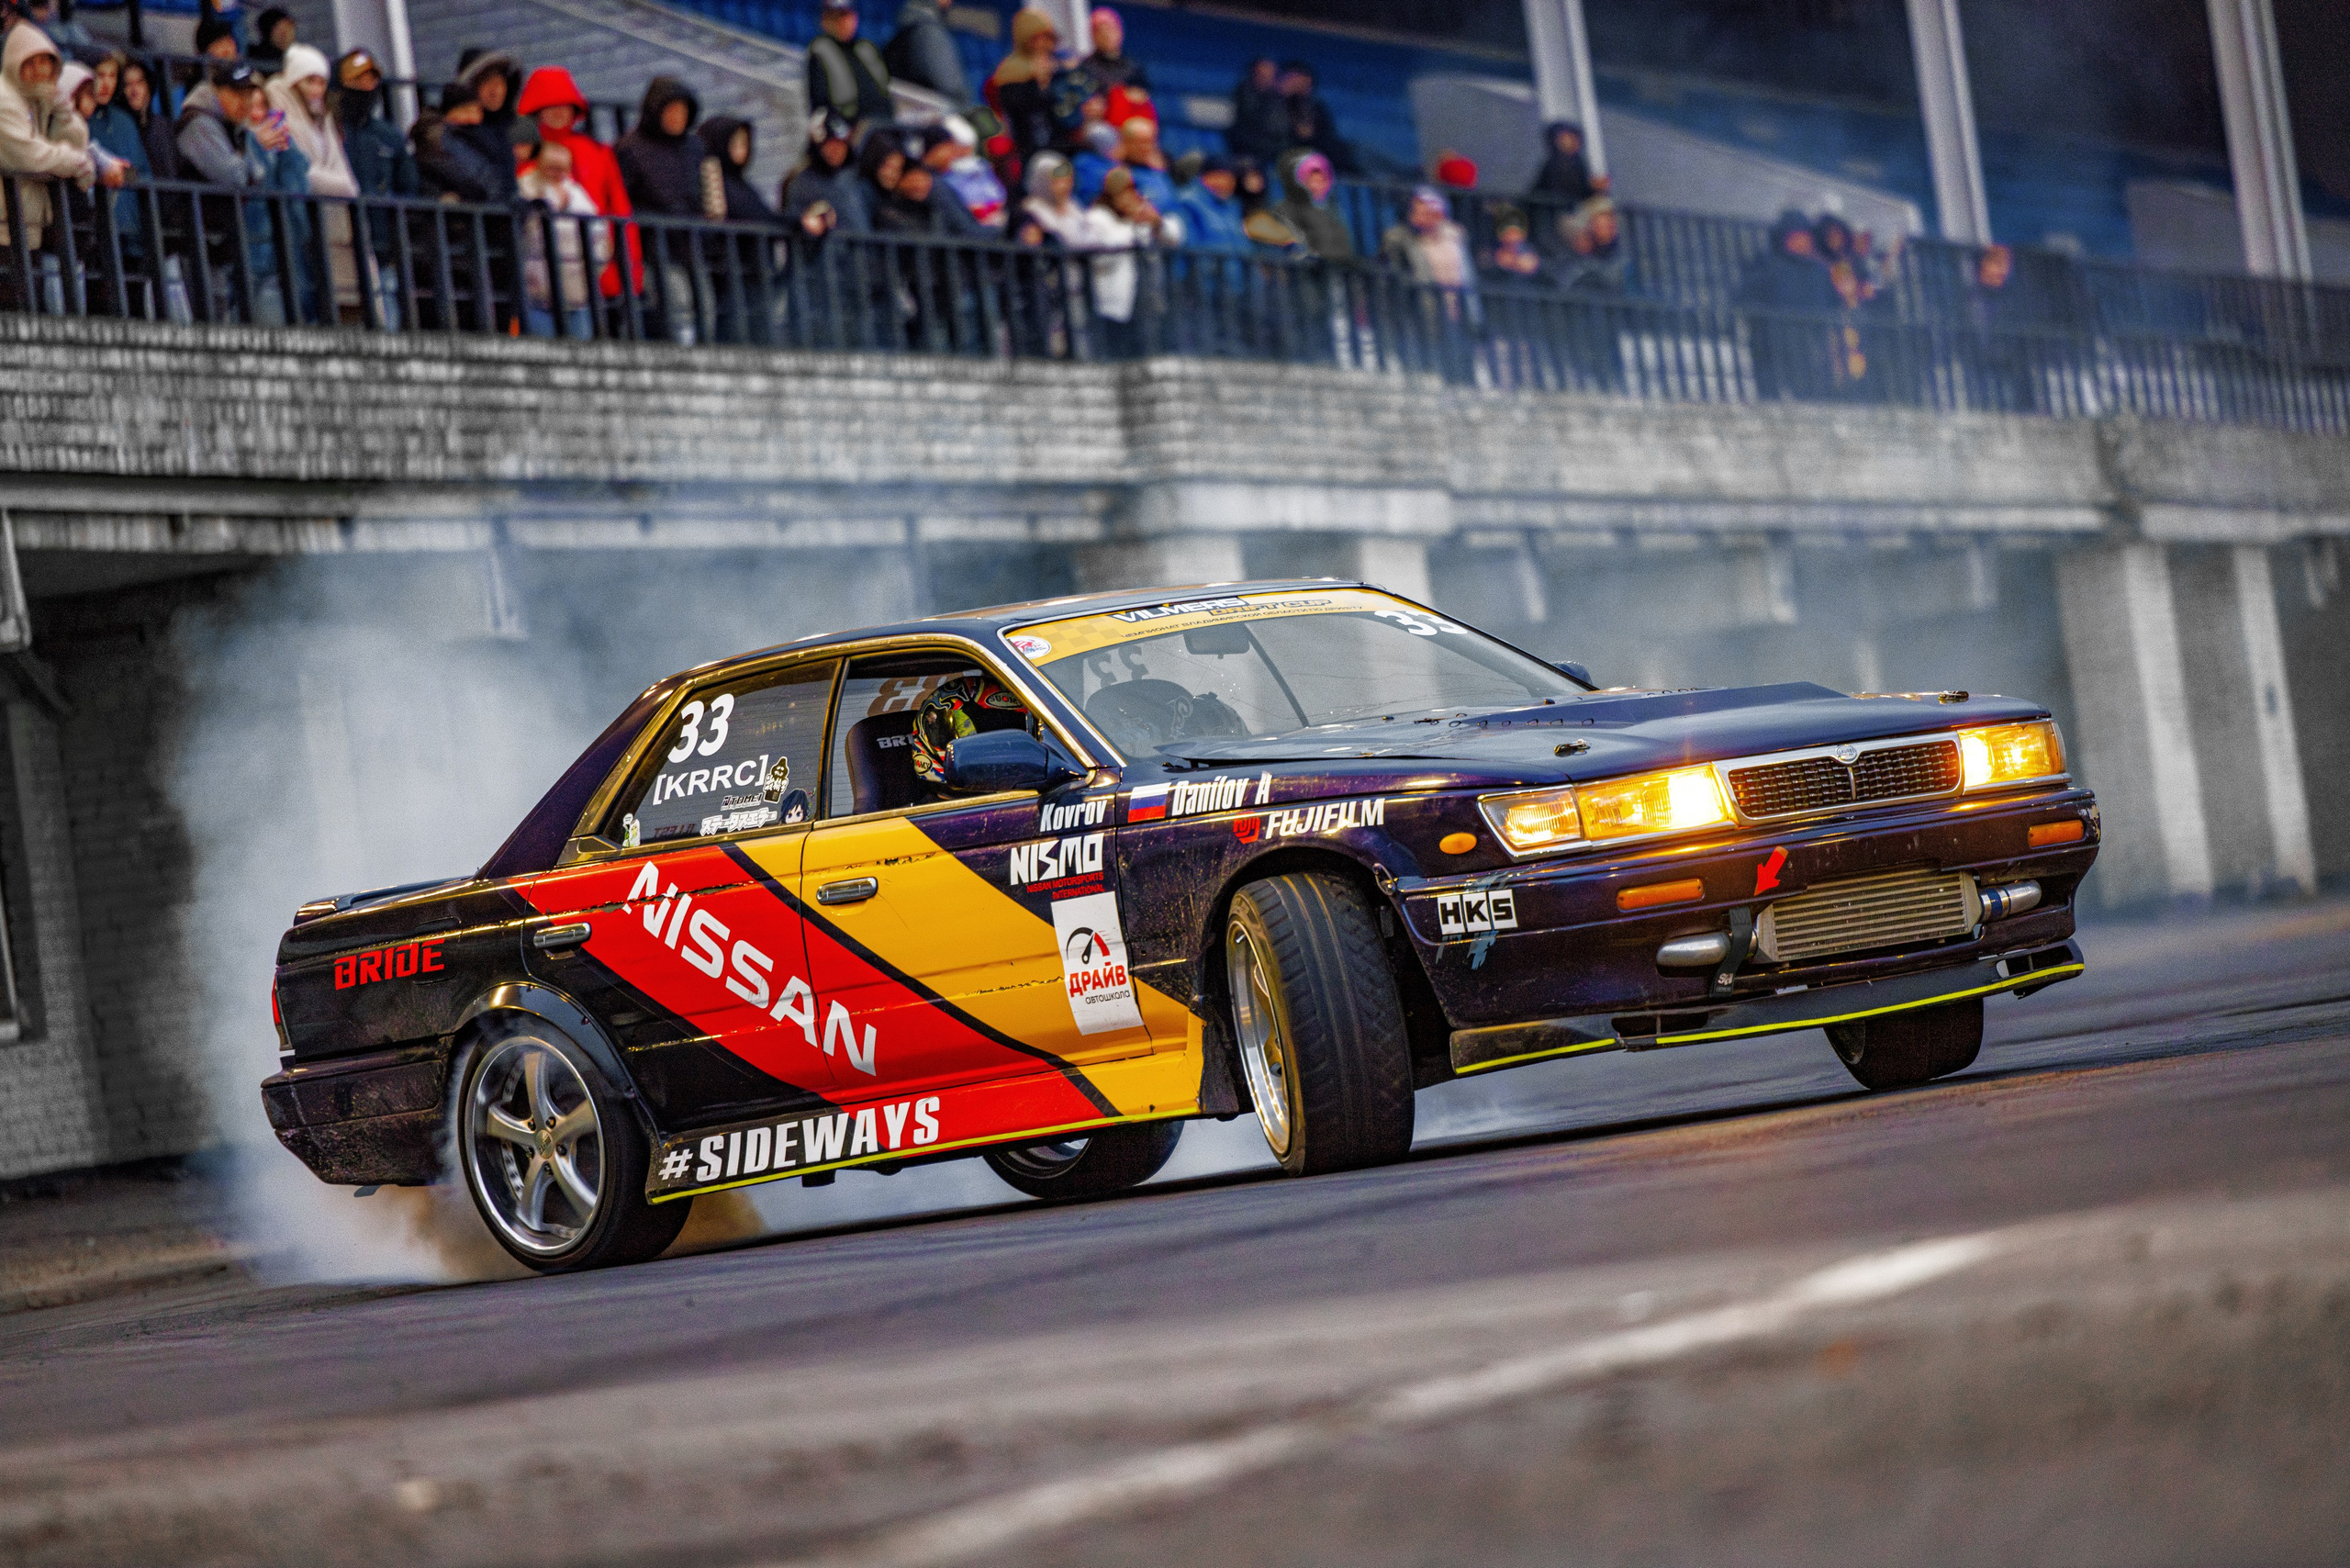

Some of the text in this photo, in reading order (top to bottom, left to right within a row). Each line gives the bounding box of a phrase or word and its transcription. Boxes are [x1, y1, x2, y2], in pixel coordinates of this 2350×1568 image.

[1280, 599, 1333, 610] CUP
[1374, 610, 1468, 636] 33
[667, 693, 735, 764] 33
[876, 734, 913, 749] BRI
[1171, 771, 1273, 816] Danilov A
[1039, 800, 1108, 833] Kovrov
[1265, 798, 1386, 840] FUJIFILM
[1011, 833, 1104, 886] NISMO
[1026, 871, 1104, 893] NISSAN MOTORSPORTS
[1052, 883, 1105, 900] INTERNATIONAL
[1438, 896, 1516, 927] HKS
[334, 937, 445, 991] BRIDE
[622, 860, 878, 1077] NISSAN
[1069, 961, 1127, 999] ДРАЙВ
[1085, 990, 1131, 1005] автошкола
[659, 1095, 941, 1183] #SIDEWAYS
